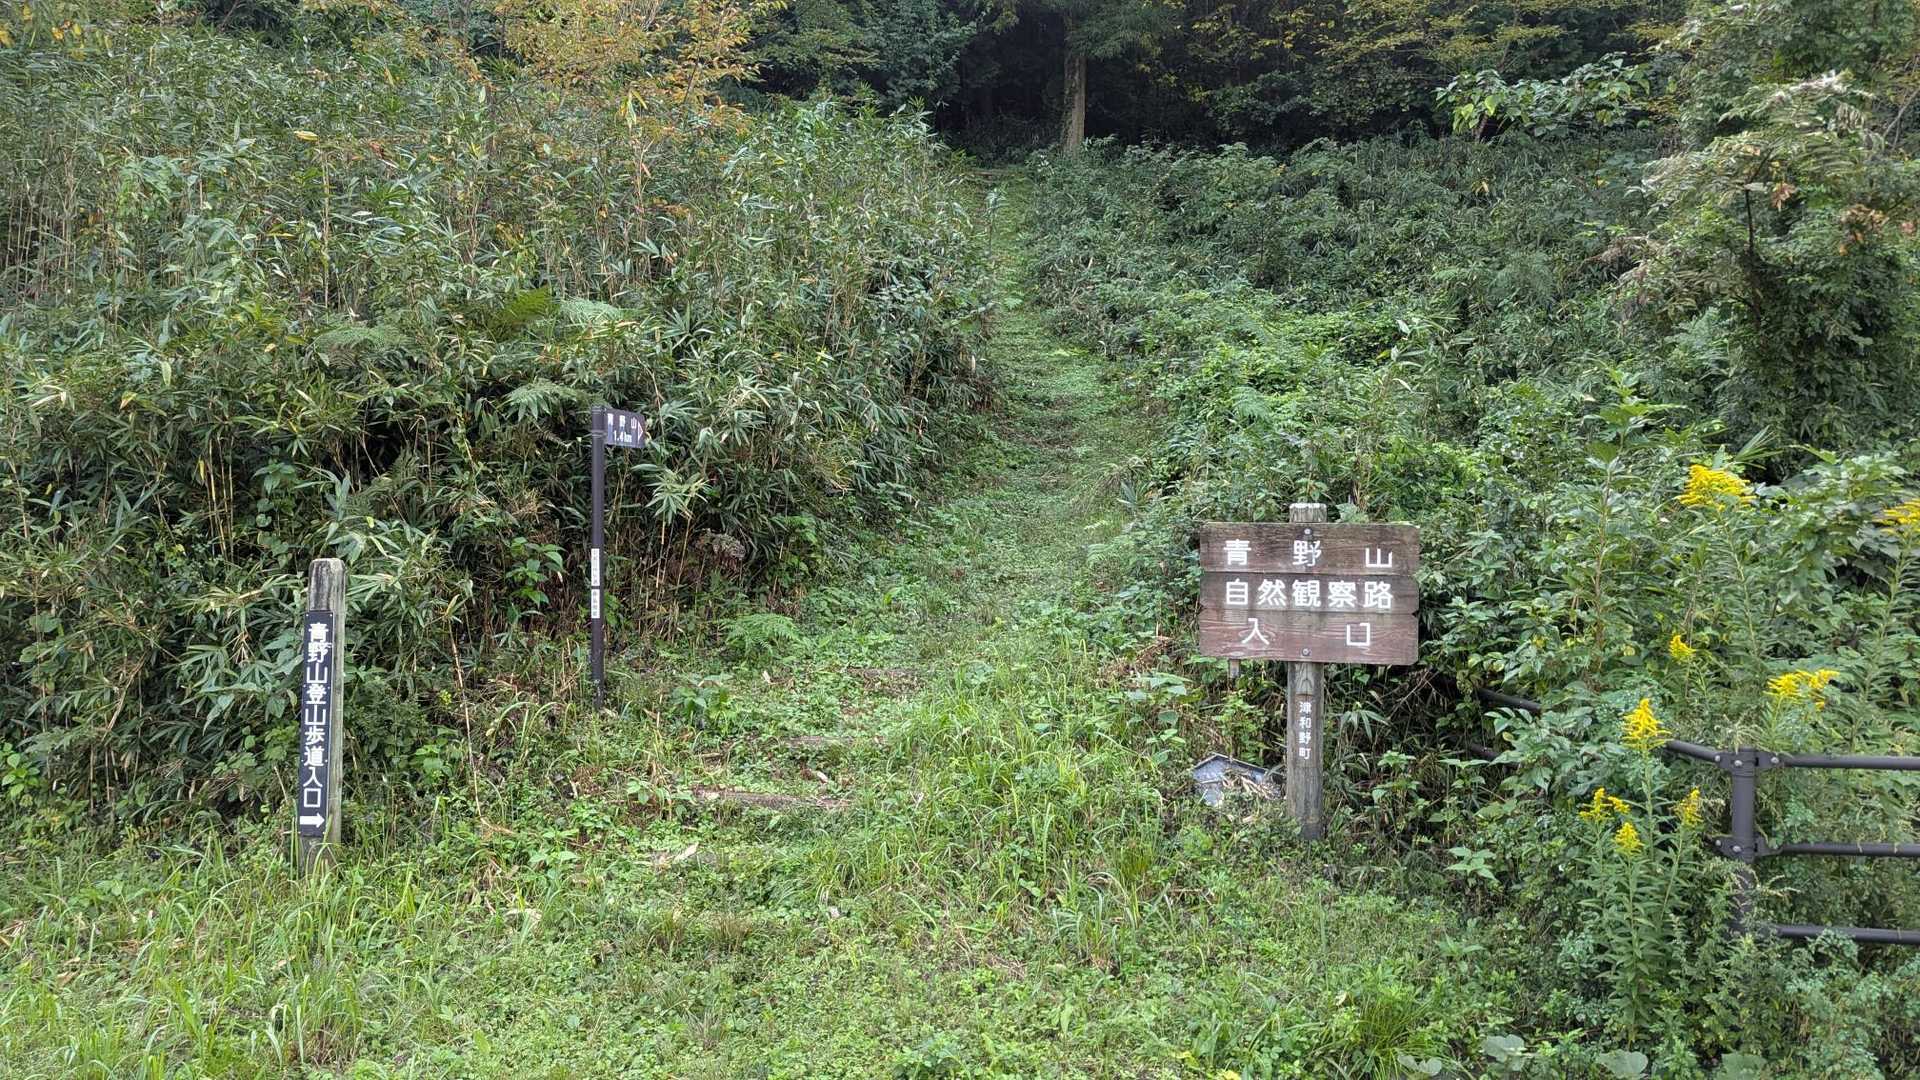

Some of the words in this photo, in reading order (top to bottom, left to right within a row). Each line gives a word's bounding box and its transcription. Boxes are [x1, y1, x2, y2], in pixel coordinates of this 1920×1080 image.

[1223, 539, 1393, 569] 青野山
[1225, 578, 1394, 610] 自然観察路
[1241, 617, 1371, 647] 入口
[303, 622, 332, 808] 青野山登山歩道入口
[1298, 701, 1312, 760] 津和野町
